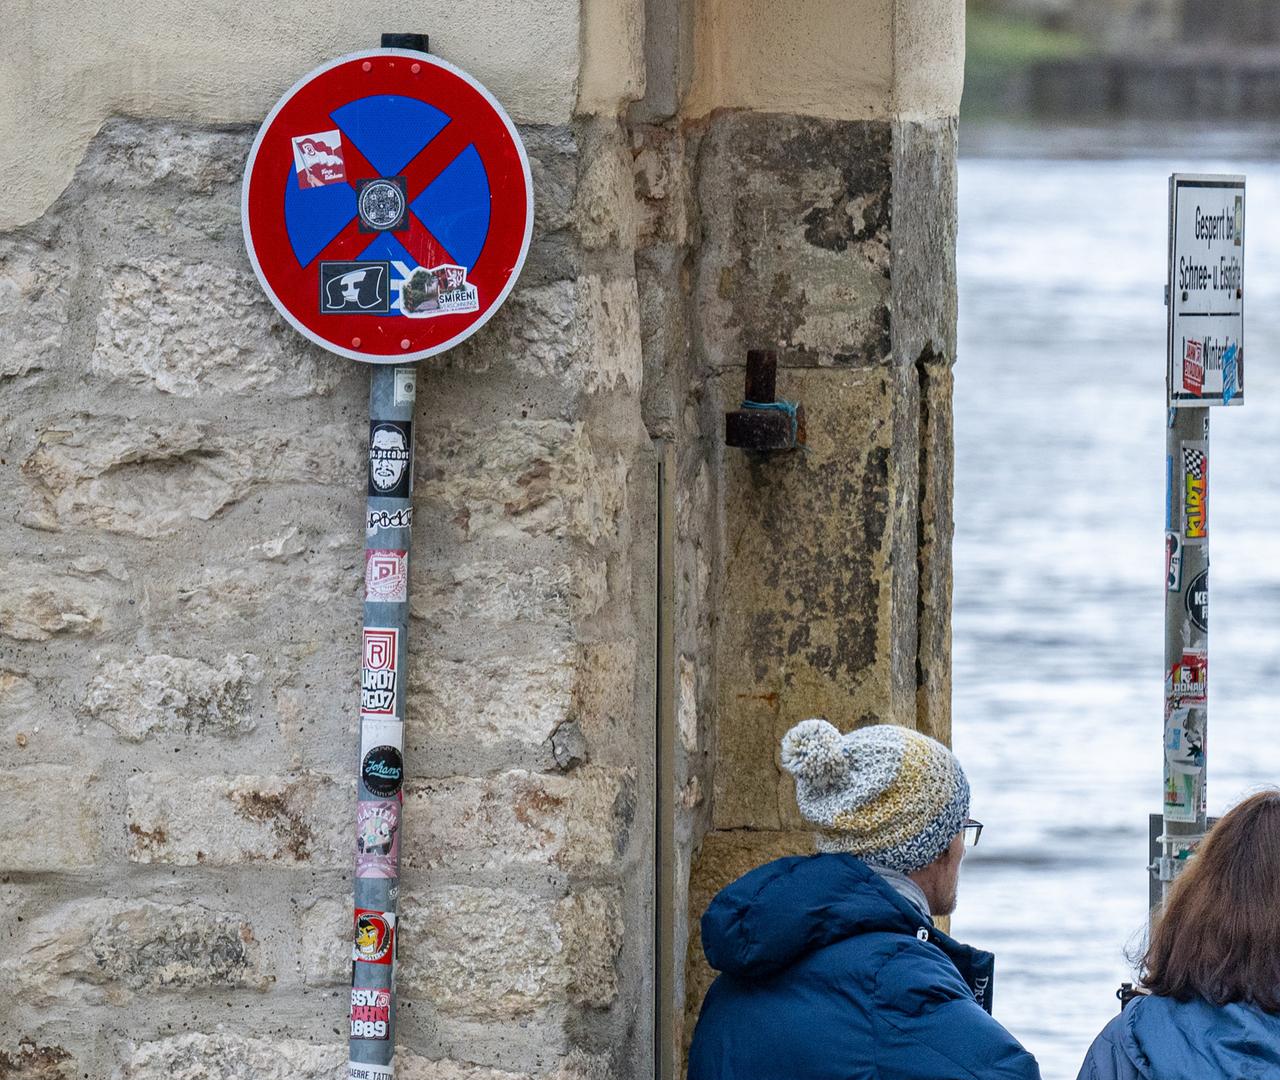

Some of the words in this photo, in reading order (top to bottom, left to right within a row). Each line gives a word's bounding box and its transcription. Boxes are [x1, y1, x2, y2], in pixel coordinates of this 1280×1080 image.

[1195, 206, 1225, 250] Gesperrt
[1179, 255, 1212, 291] Schnee-
[1213, 265, 1220, 290] u.
[439, 288, 476, 304] SMÍŘENÍ
[365, 760, 401, 779] Johans
[352, 989, 379, 1007] SSV
[352, 1006, 389, 1022] JAHN
[351, 1021, 387, 1037] 1889
